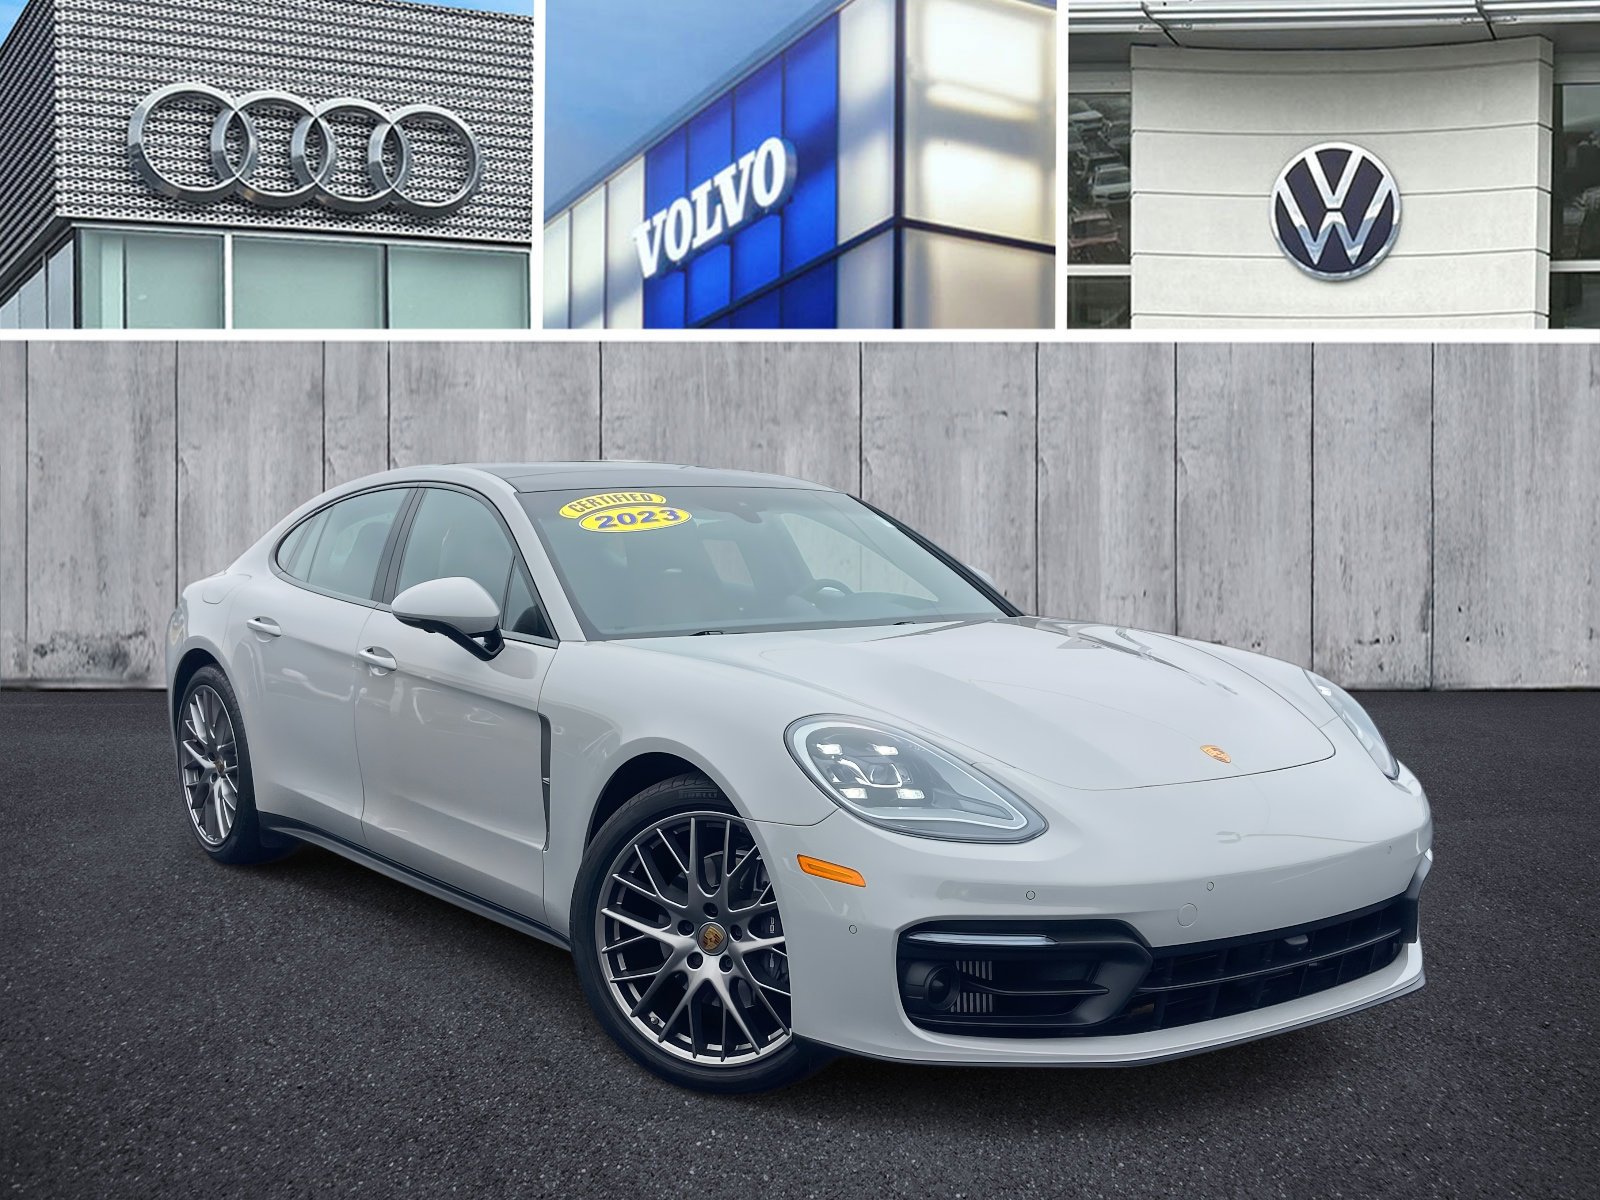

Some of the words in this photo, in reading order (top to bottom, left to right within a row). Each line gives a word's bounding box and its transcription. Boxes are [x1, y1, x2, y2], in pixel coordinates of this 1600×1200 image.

[632, 136, 788, 279] VOLVO
[1272, 143, 1399, 277] VW
[567, 492, 654, 513] CERTIFIED
[594, 509, 681, 529] 2023
